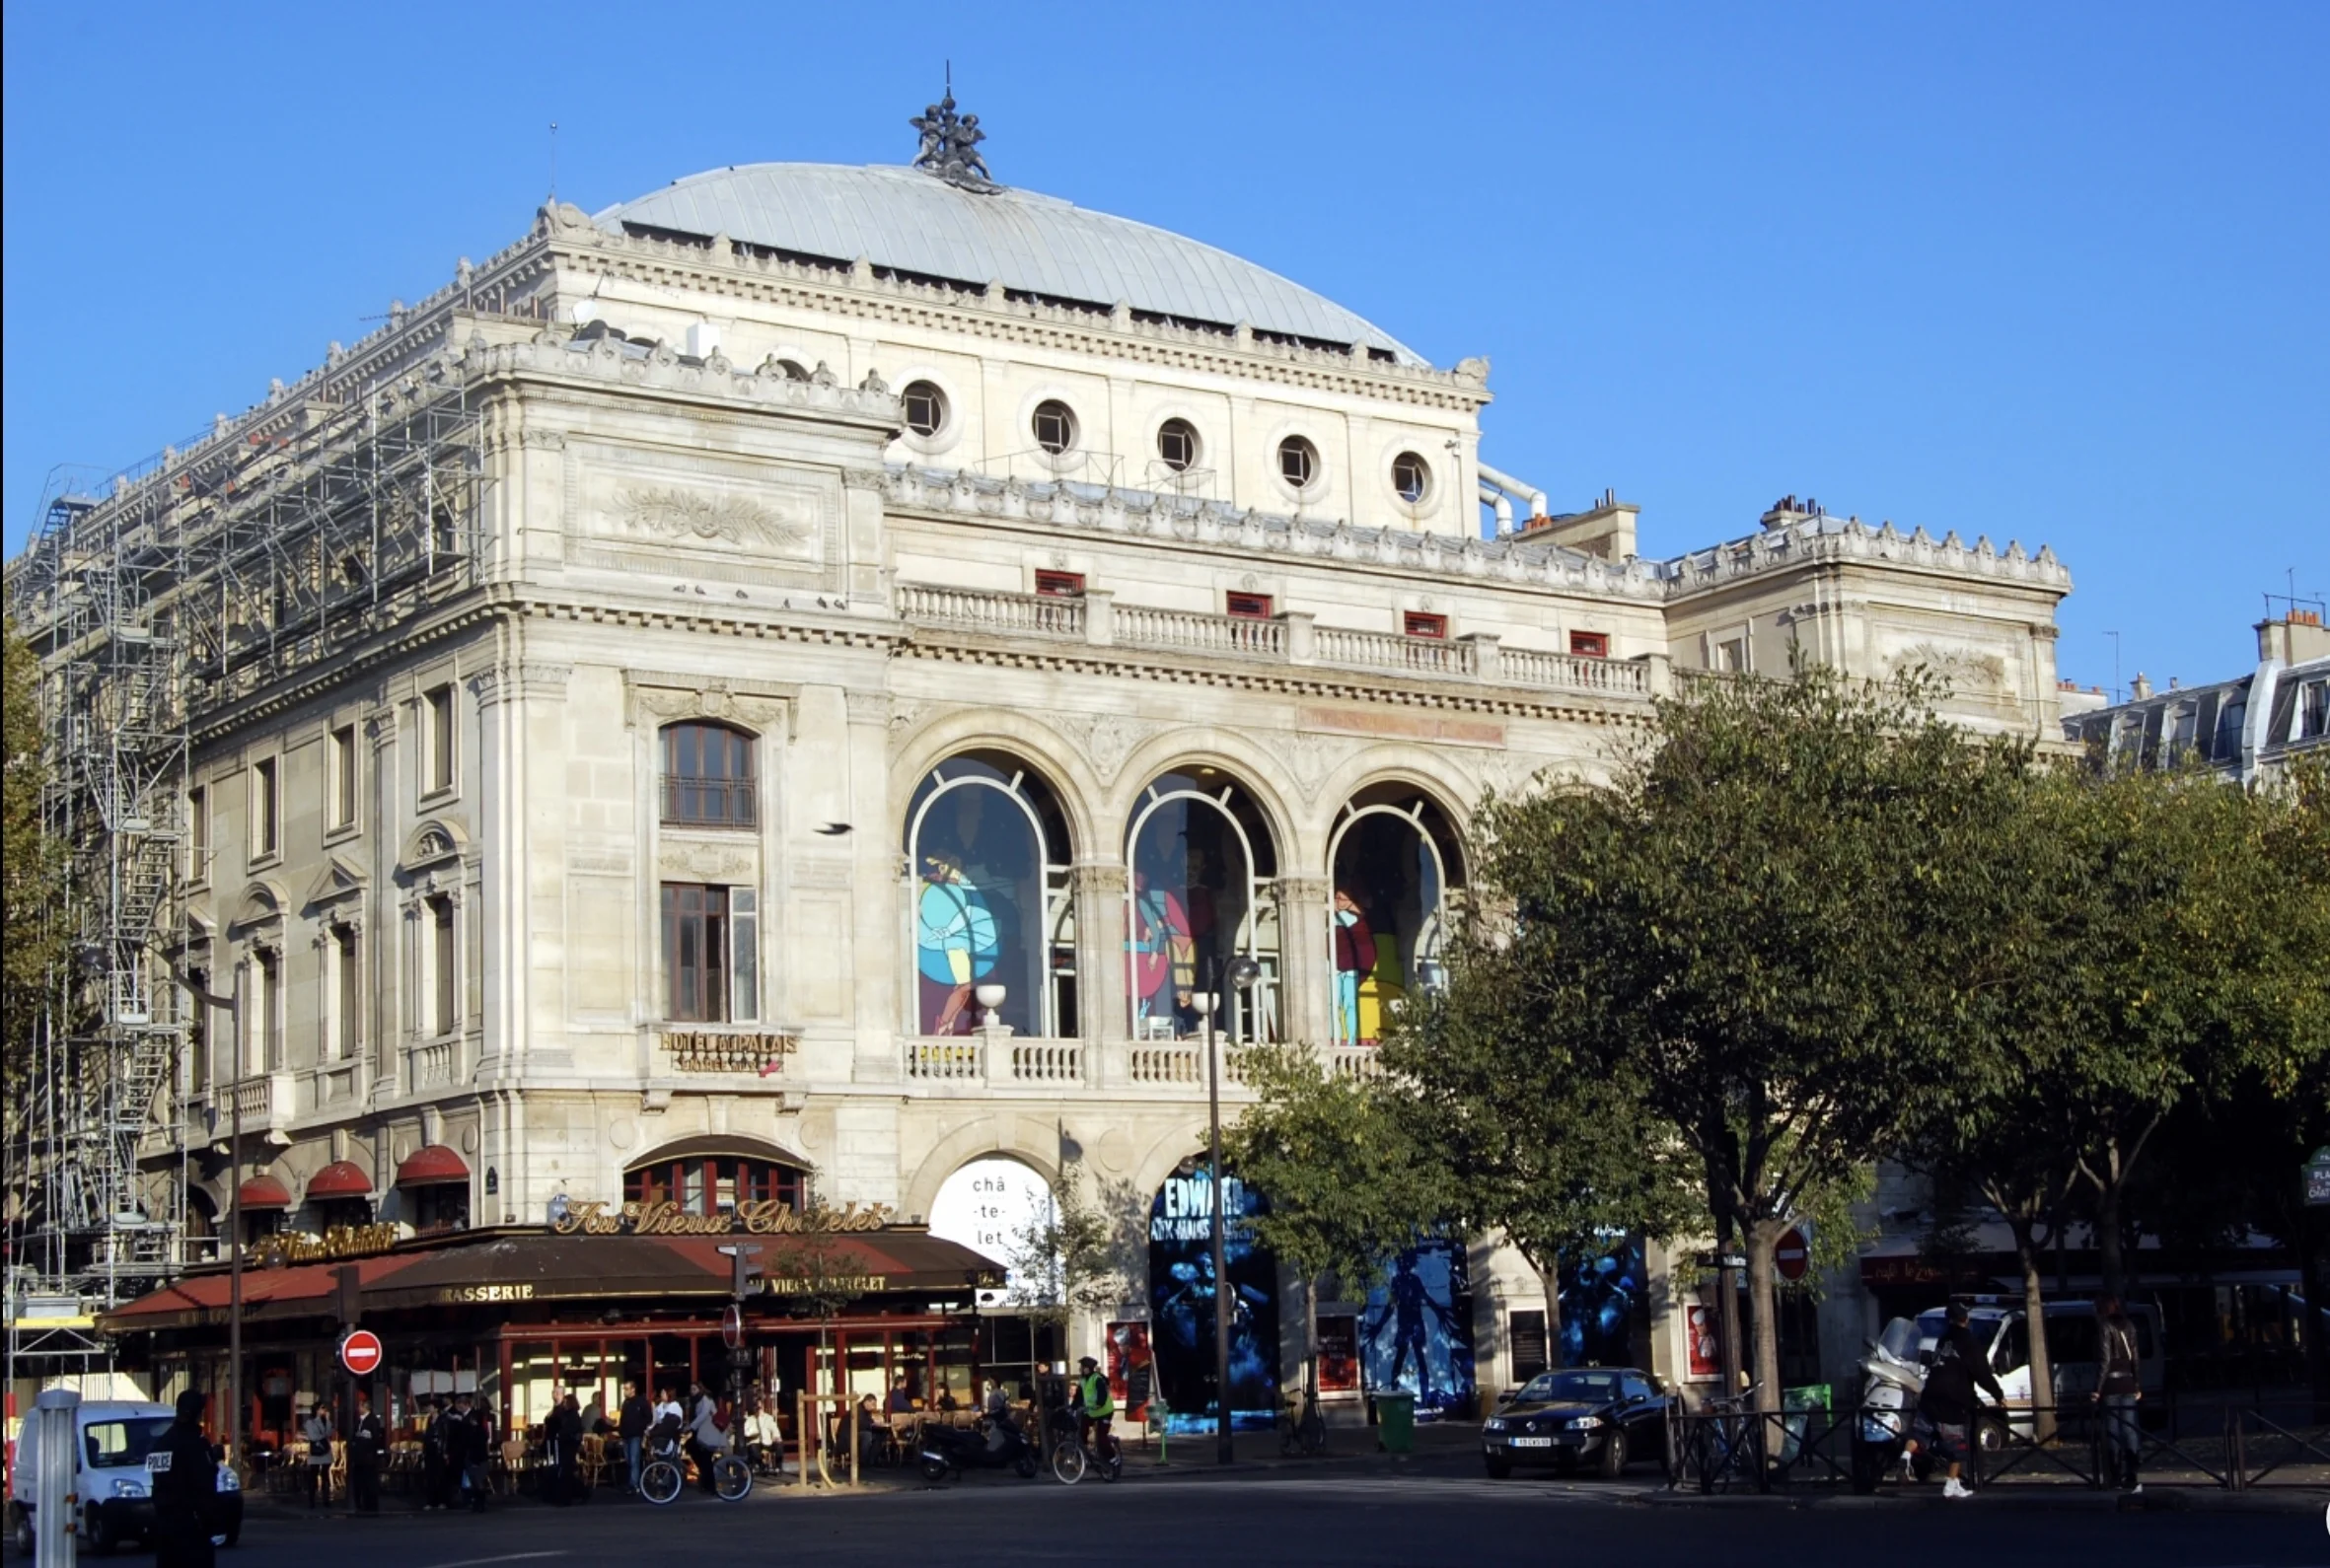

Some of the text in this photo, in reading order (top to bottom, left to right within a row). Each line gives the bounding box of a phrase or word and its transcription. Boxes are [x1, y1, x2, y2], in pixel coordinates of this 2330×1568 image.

[973, 1176, 1005, 1192] châ
[555, 1200, 620, 1234] Au
[622, 1200, 733, 1234] Vieux
[977, 1229, 1004, 1245] let
